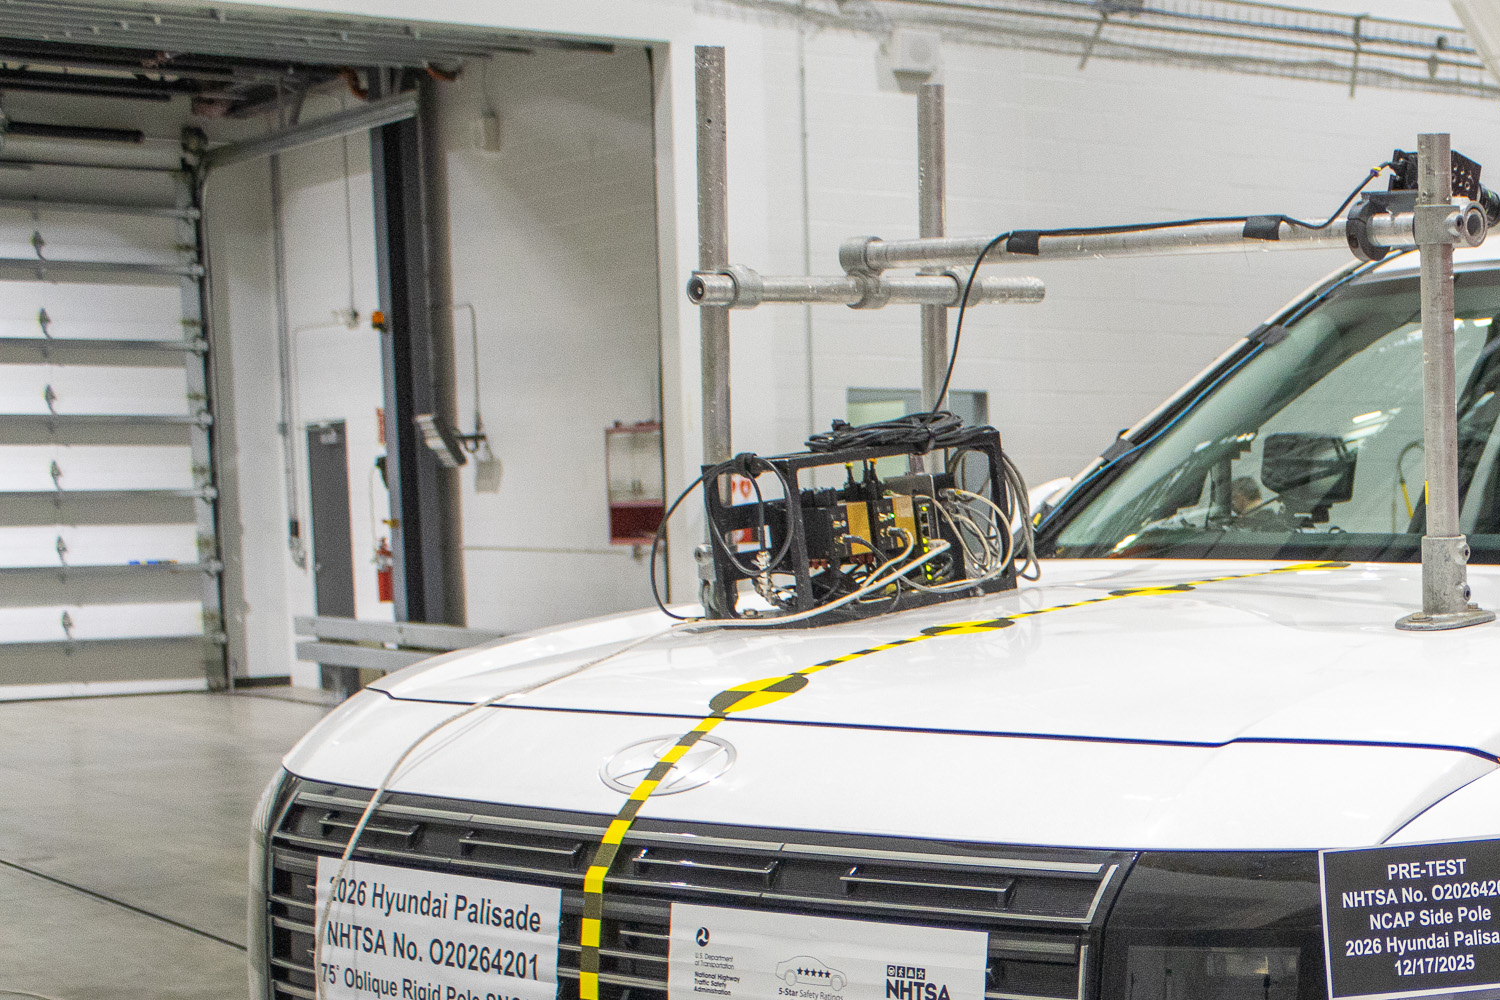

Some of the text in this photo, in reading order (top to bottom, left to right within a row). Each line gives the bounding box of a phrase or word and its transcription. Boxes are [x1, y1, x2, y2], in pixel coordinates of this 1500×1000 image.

[1387, 858, 1467, 880] PRE-TEST
[372, 883, 448, 919] Hyundai
[454, 894, 541, 932] Palisade
[1342, 888, 1398, 909] NHTSA
[1402, 886, 1428, 904] No.
[1370, 905, 1492, 930] NCAP Side Pole
[327, 920, 538, 980] NHTSA No. O20264201
[1345, 938, 1382, 957] 2026
[1386, 931, 1449, 956] Hyundai
[1394, 954, 1475, 976] 12/17/2025
[344, 968, 397, 999] Oblique
[778, 987, 798, 997] 5-Star
[799, 989, 819, 1000] Safety
